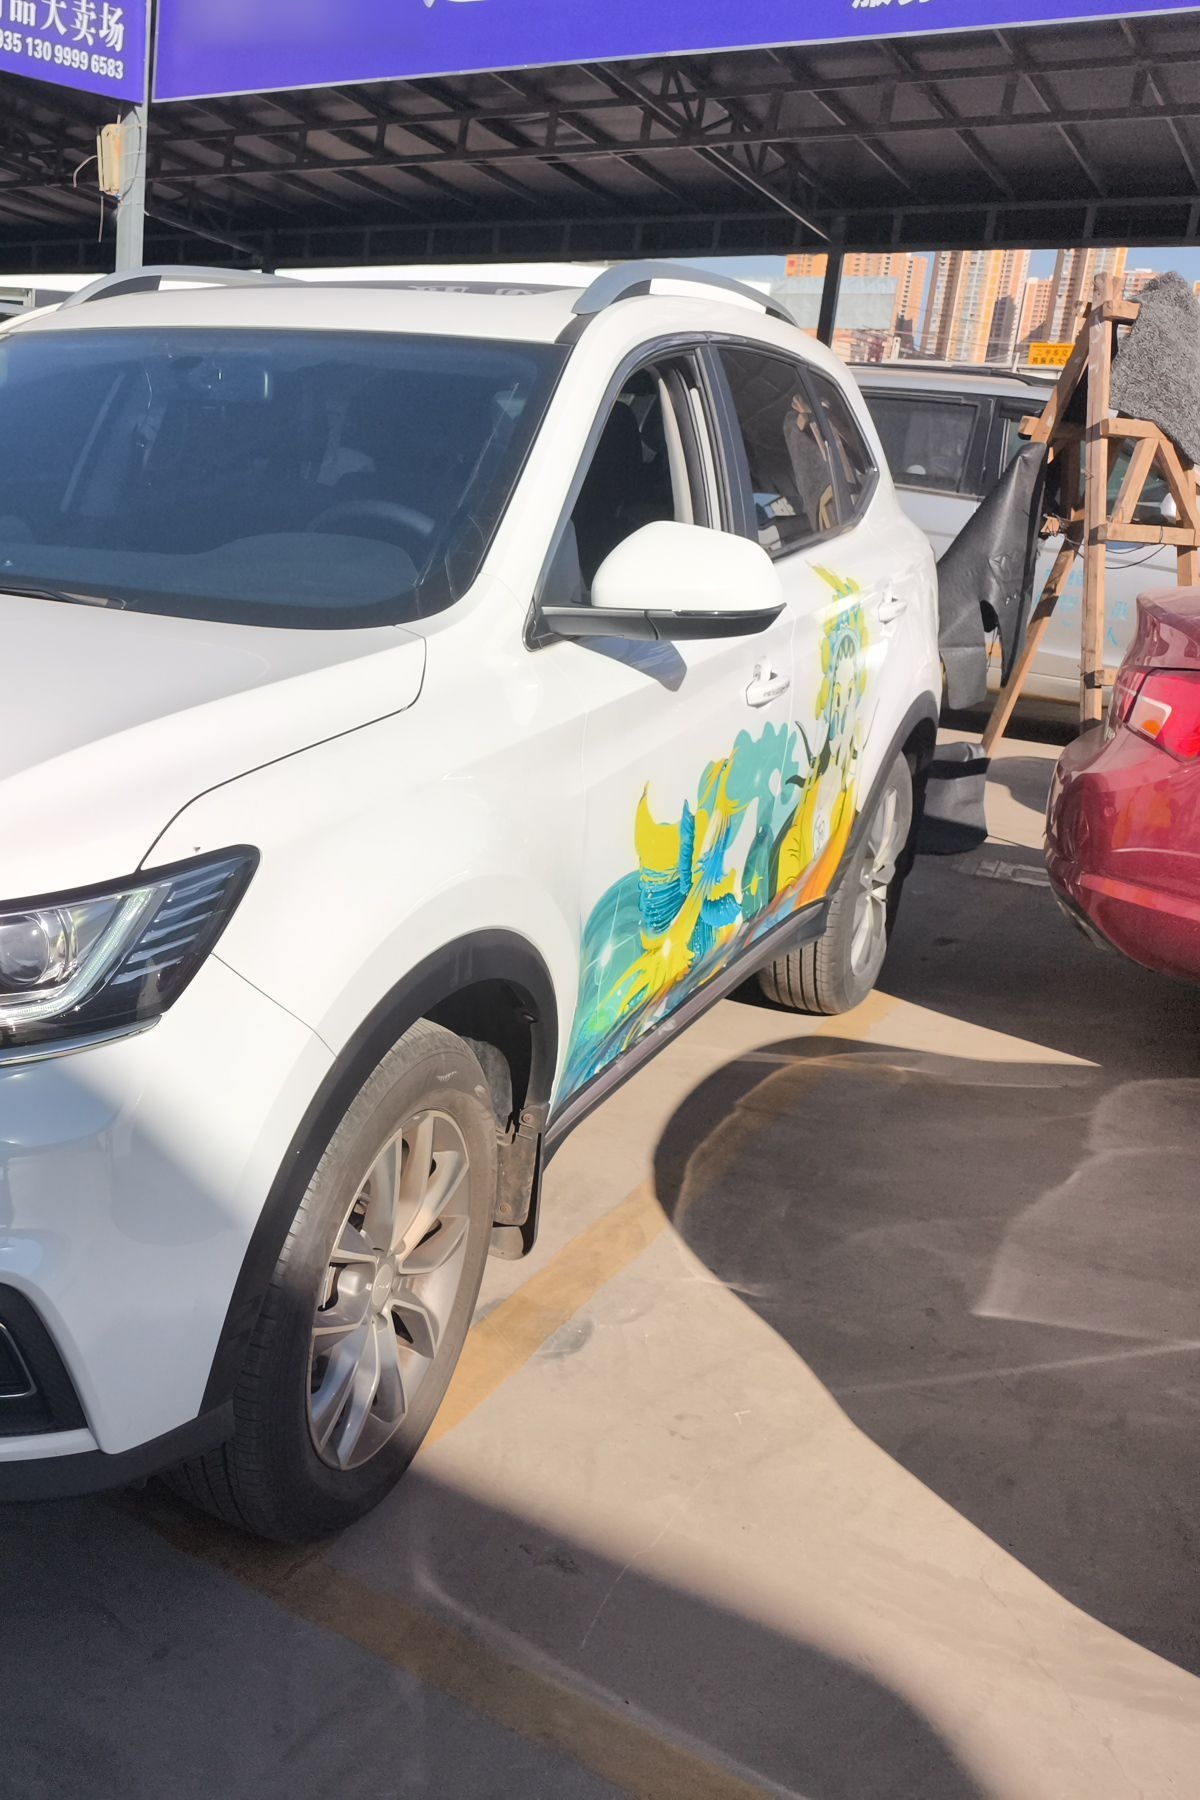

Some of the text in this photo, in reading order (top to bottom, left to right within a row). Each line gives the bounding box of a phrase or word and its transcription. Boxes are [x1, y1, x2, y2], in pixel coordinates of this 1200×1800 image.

[25, 37, 52, 61] 130
[54, 44, 88, 71] 9999
[90, 54, 124, 80] 6583
